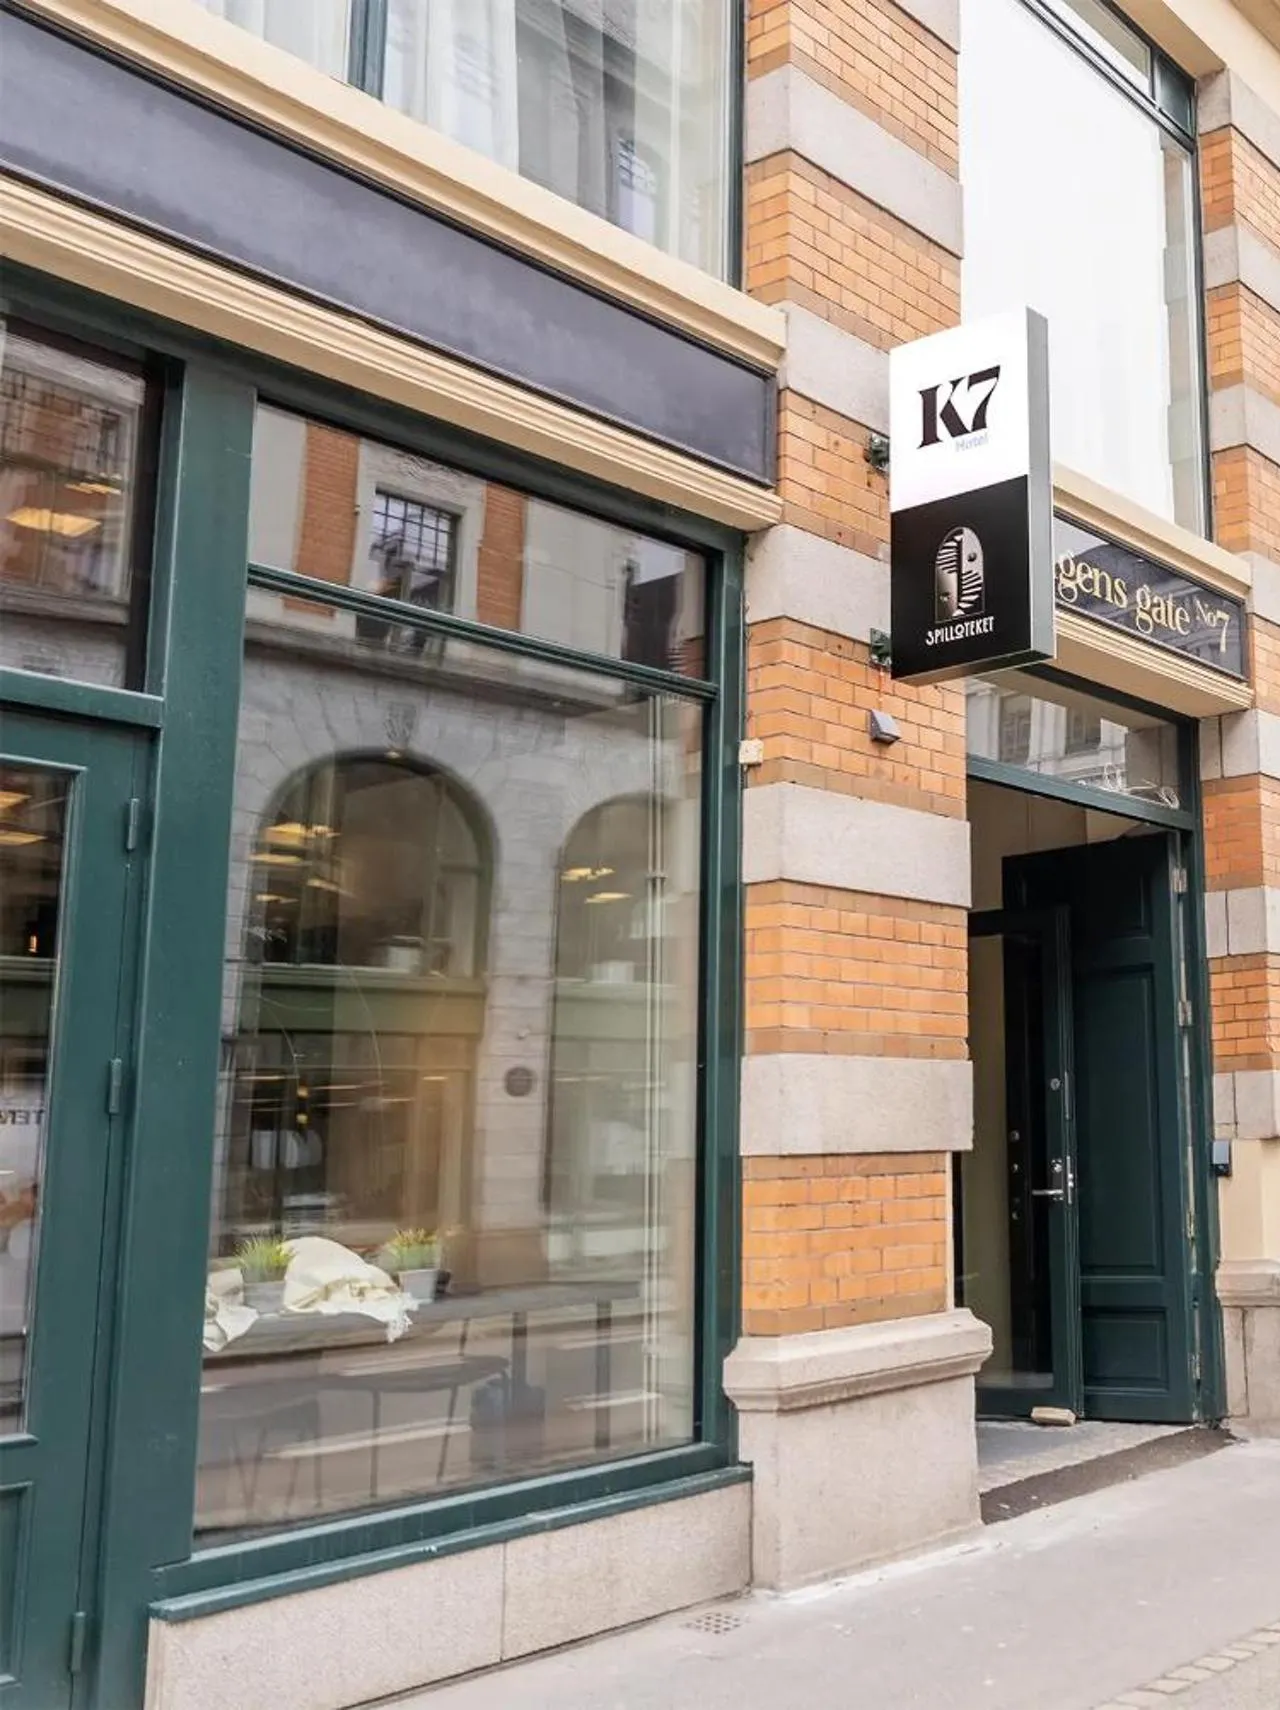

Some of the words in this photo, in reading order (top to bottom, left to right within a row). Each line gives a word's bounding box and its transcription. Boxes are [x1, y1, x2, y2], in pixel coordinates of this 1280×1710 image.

[916, 364, 1001, 449] K7
[925, 615, 995, 646] SPILLOTEKET
[1055, 550, 1128, 609] gens
[1136, 584, 1191, 636] gate
